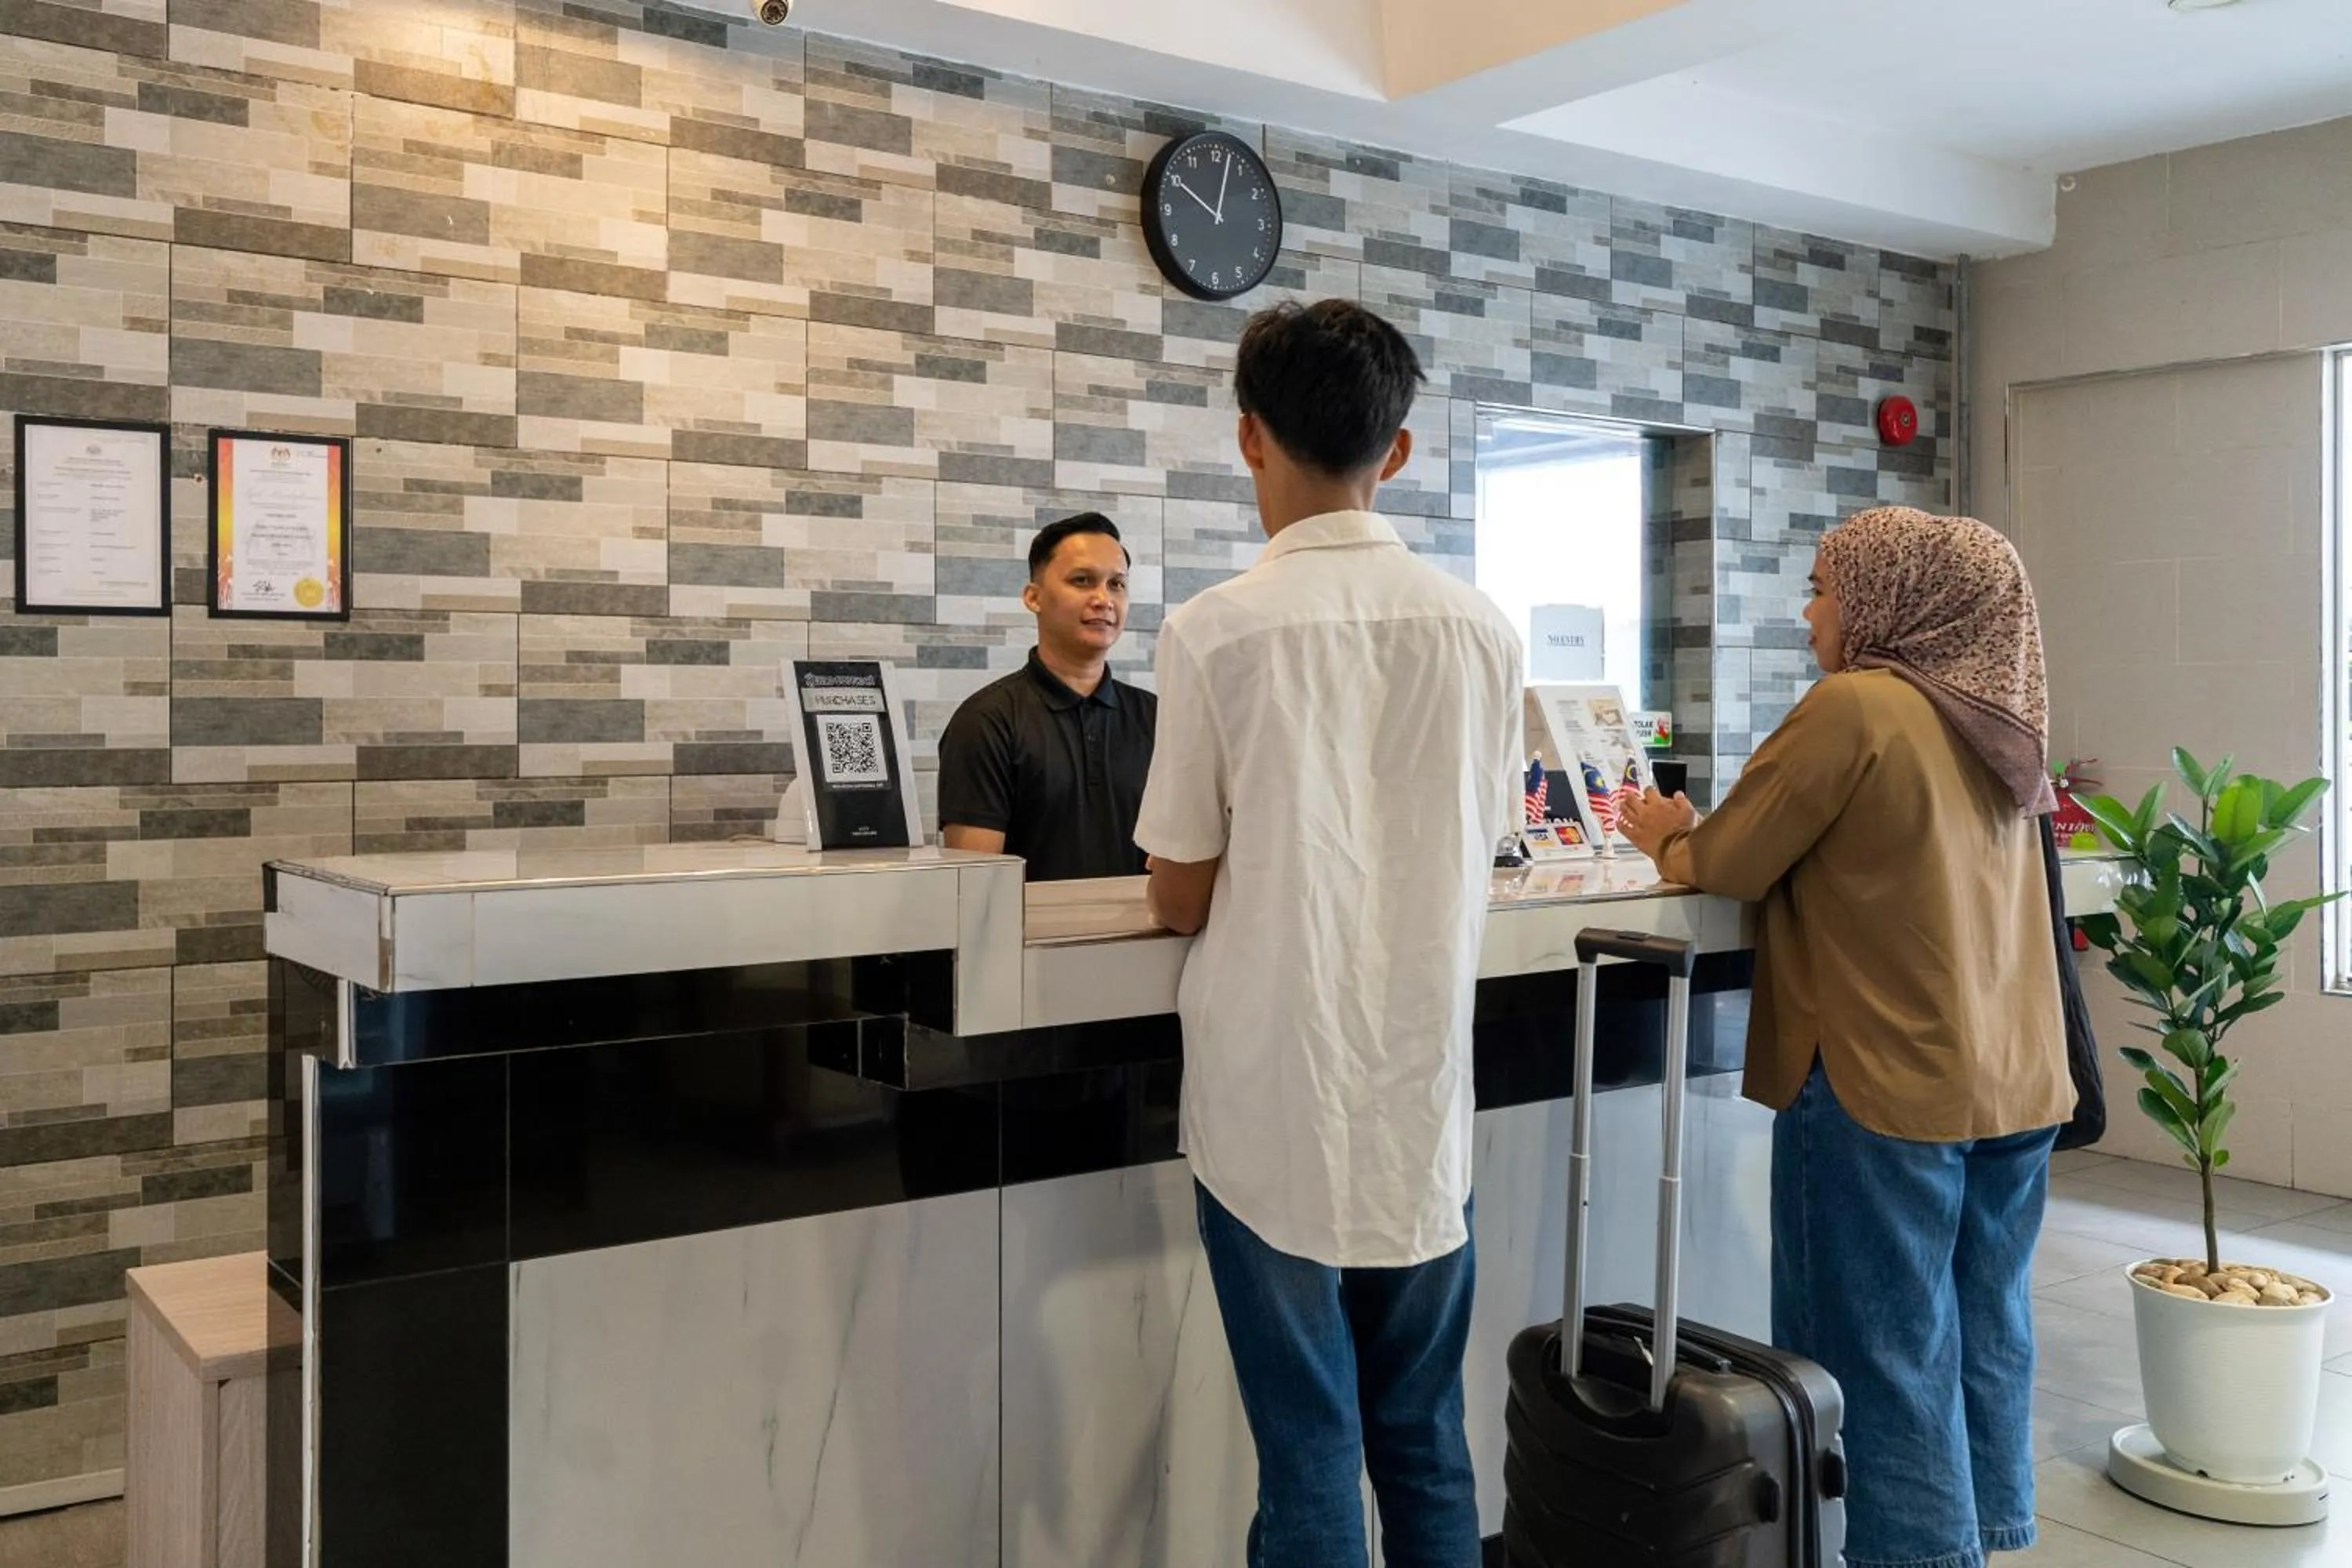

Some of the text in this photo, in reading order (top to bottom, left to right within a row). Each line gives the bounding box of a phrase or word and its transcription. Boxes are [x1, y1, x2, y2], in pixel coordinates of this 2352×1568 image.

[1188, 156, 1198, 169] 11
[1210, 150, 1221, 163] 12
[1238, 164, 1243, 176] 1
[1171, 174, 1181, 187] 10
[1251, 187, 1259, 200] 2
[1164, 203, 1172, 216] 9
[1258, 219, 1265, 231] 3
[1171, 234, 1178, 246] 8
[1188, 259, 1196, 271] 7
[1235, 265, 1243, 278] 5
[1211, 271, 1219, 285] 6
